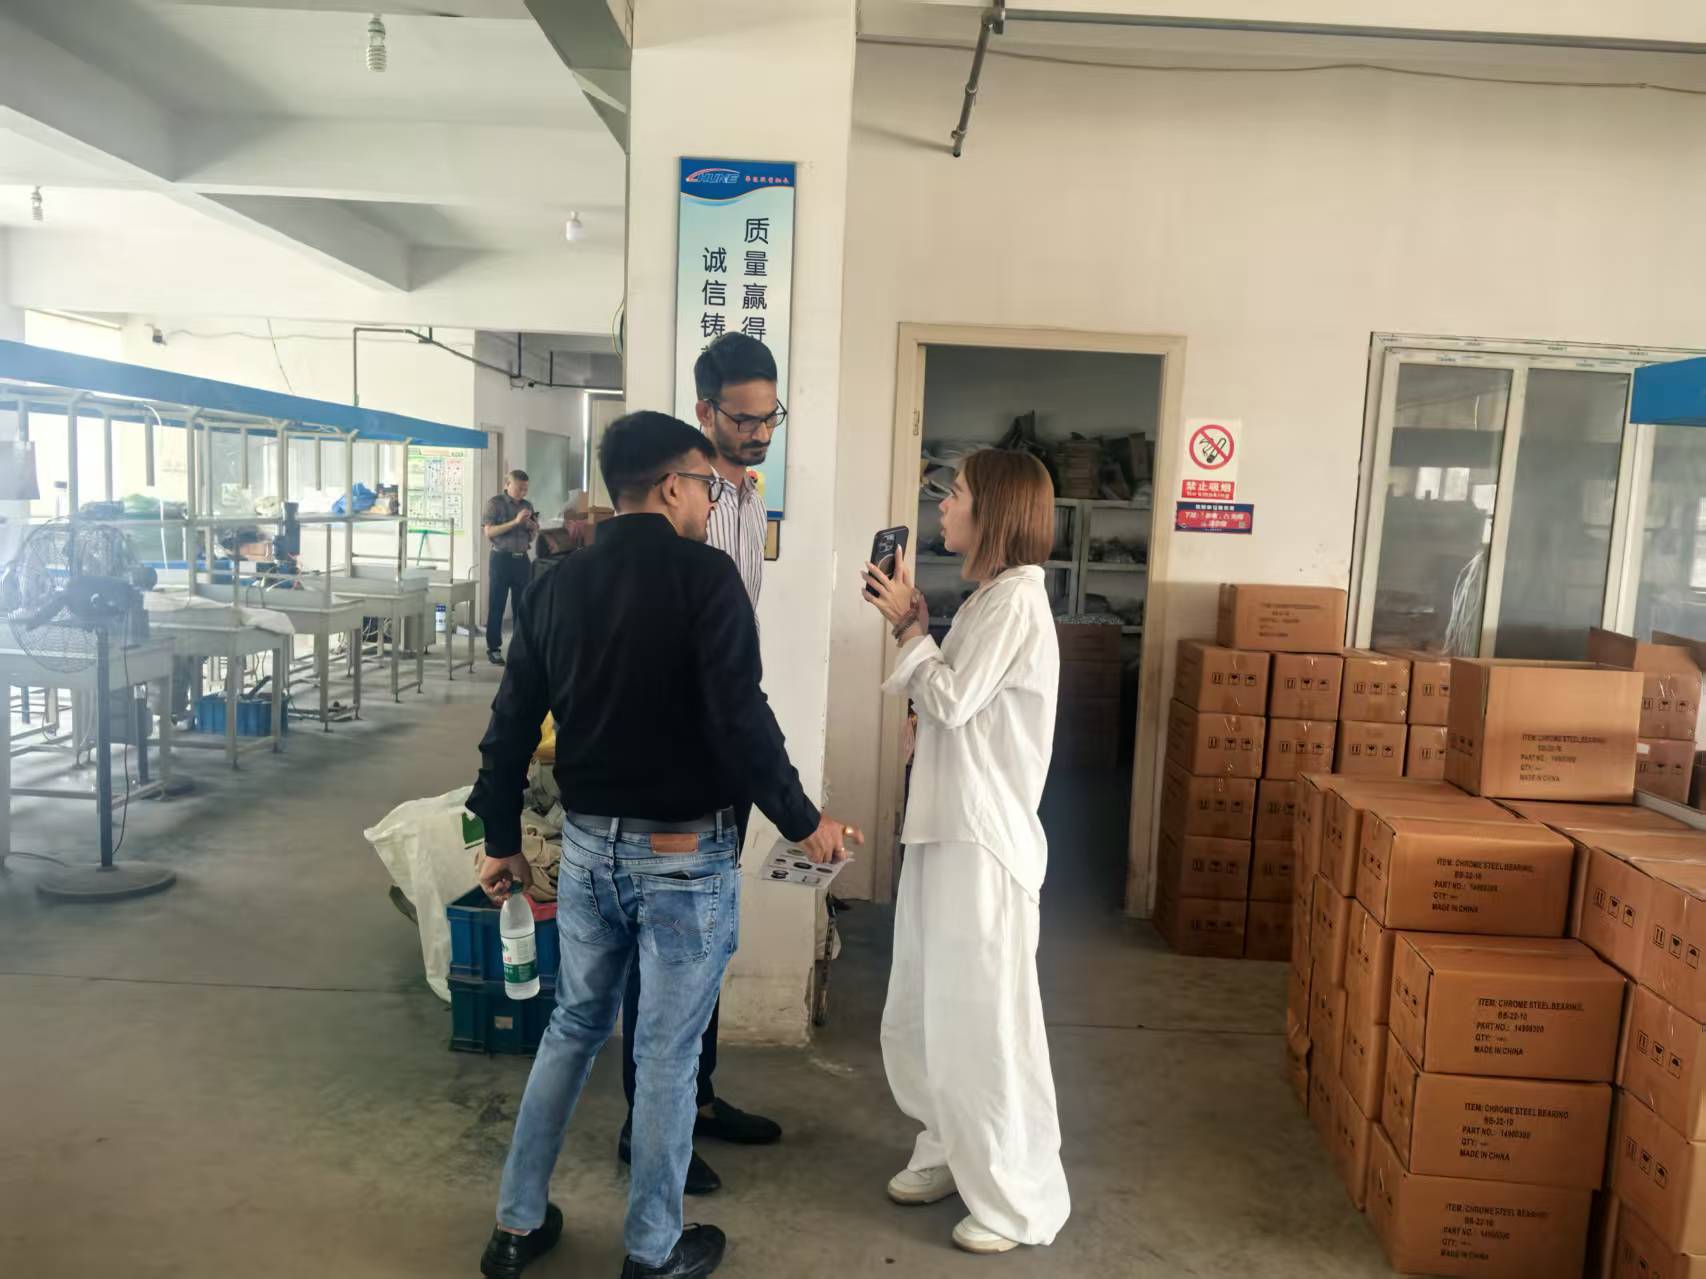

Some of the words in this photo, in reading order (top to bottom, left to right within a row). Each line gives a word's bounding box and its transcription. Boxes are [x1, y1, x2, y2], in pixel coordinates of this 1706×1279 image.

[700, 246, 727, 350] 诚信铸
[741, 217, 770, 341] 质量赢得
[1473, 1045, 1493, 1054] MADE
[1502, 1046, 1524, 1056] CHINA
[1459, 1149, 1479, 1158] MADE
[1480, 1150, 1487, 1159] IN
[1488, 1151, 1511, 1160] CHINA
